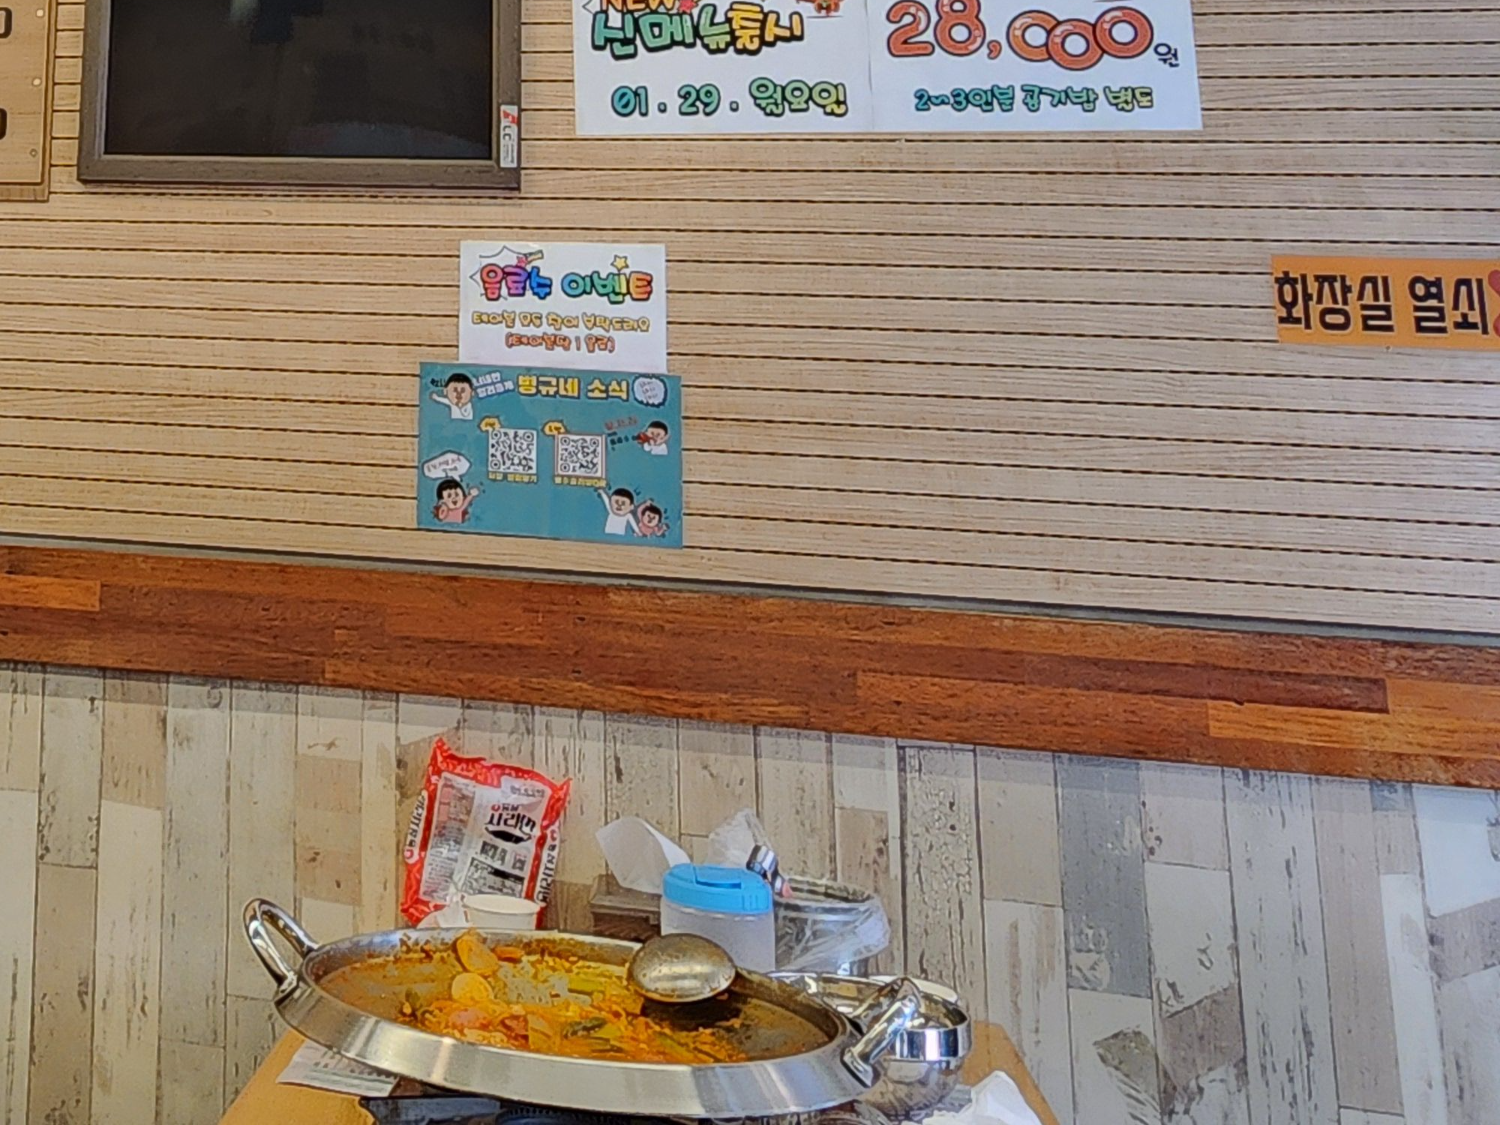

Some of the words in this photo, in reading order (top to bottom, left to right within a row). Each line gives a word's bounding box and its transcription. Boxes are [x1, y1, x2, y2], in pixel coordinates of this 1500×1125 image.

[750, 77, 848, 117] 월요일
[1021, 84, 1099, 112] 공기밥
[1105, 86, 1154, 112] 별도
[561, 270, 653, 305] 이벤트
[1274, 271, 1395, 333] 화장실
[1408, 275, 1489, 336] 열쇠
[586, 377, 629, 402] 소식
